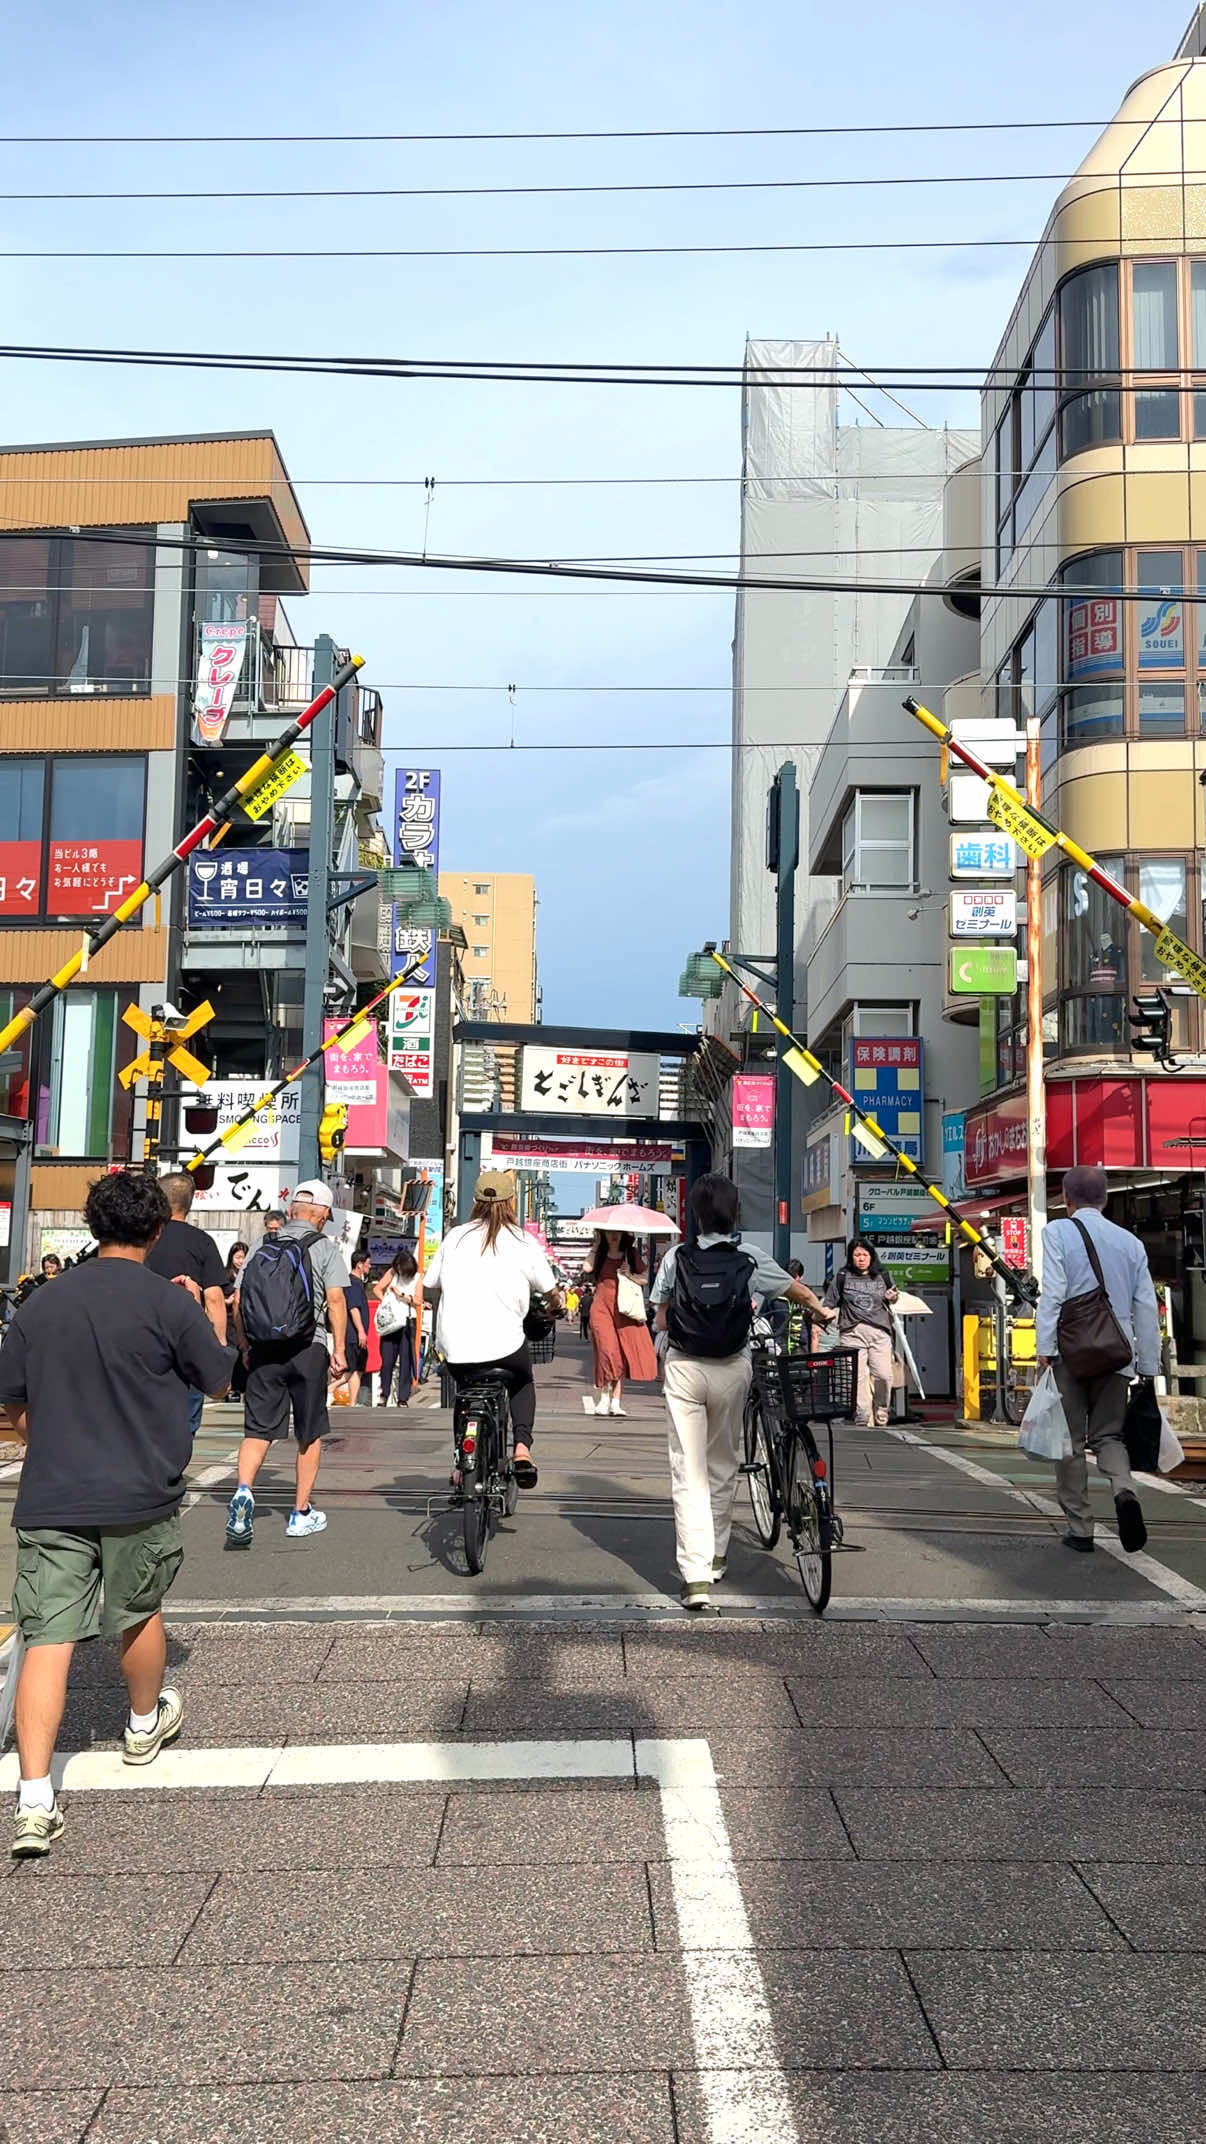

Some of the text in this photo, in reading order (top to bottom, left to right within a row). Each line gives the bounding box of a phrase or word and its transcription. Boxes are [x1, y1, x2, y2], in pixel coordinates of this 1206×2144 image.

[205, 626, 245, 638] Crepe
[1144, 639, 1179, 649] SOUEI
[204, 646, 234, 726] クレープ
[245, 758, 295, 805] 無理な横断は
[405, 772, 430, 789] 2F
[253, 766, 301, 814] おやめ下さい
[988, 805, 1037, 854] おやめ下さい
[54, 848, 98, 859] 当ビル3階
[956, 842, 1010, 869] 歯科
[54, 862, 107, 873] お一人様でも
[221, 861, 248, 876] 酒場
[54, 876, 116, 888] お気軽にどうぞ
[220, 878, 287, 900] 宵日々
[972, 906, 996, 917] 創英
[402, 1037, 419, 1050] 酒
[857, 1046, 916, 1062] 保険調剤
[392, 1055, 429, 1068] たばこ
[561, 1056, 624, 1067] 好きですこの街
[533, 1069, 649, 1107] とごしぎんざ
[863, 1096, 912, 1107] PHARMACY
[219, 1114, 268, 1124] SMONG
[506, 1157, 568, 1169] 戸越銀座商店街
[863, 1202, 876, 1211] 6F
[887, 1251, 945, 1261] 創英ゼミナール
